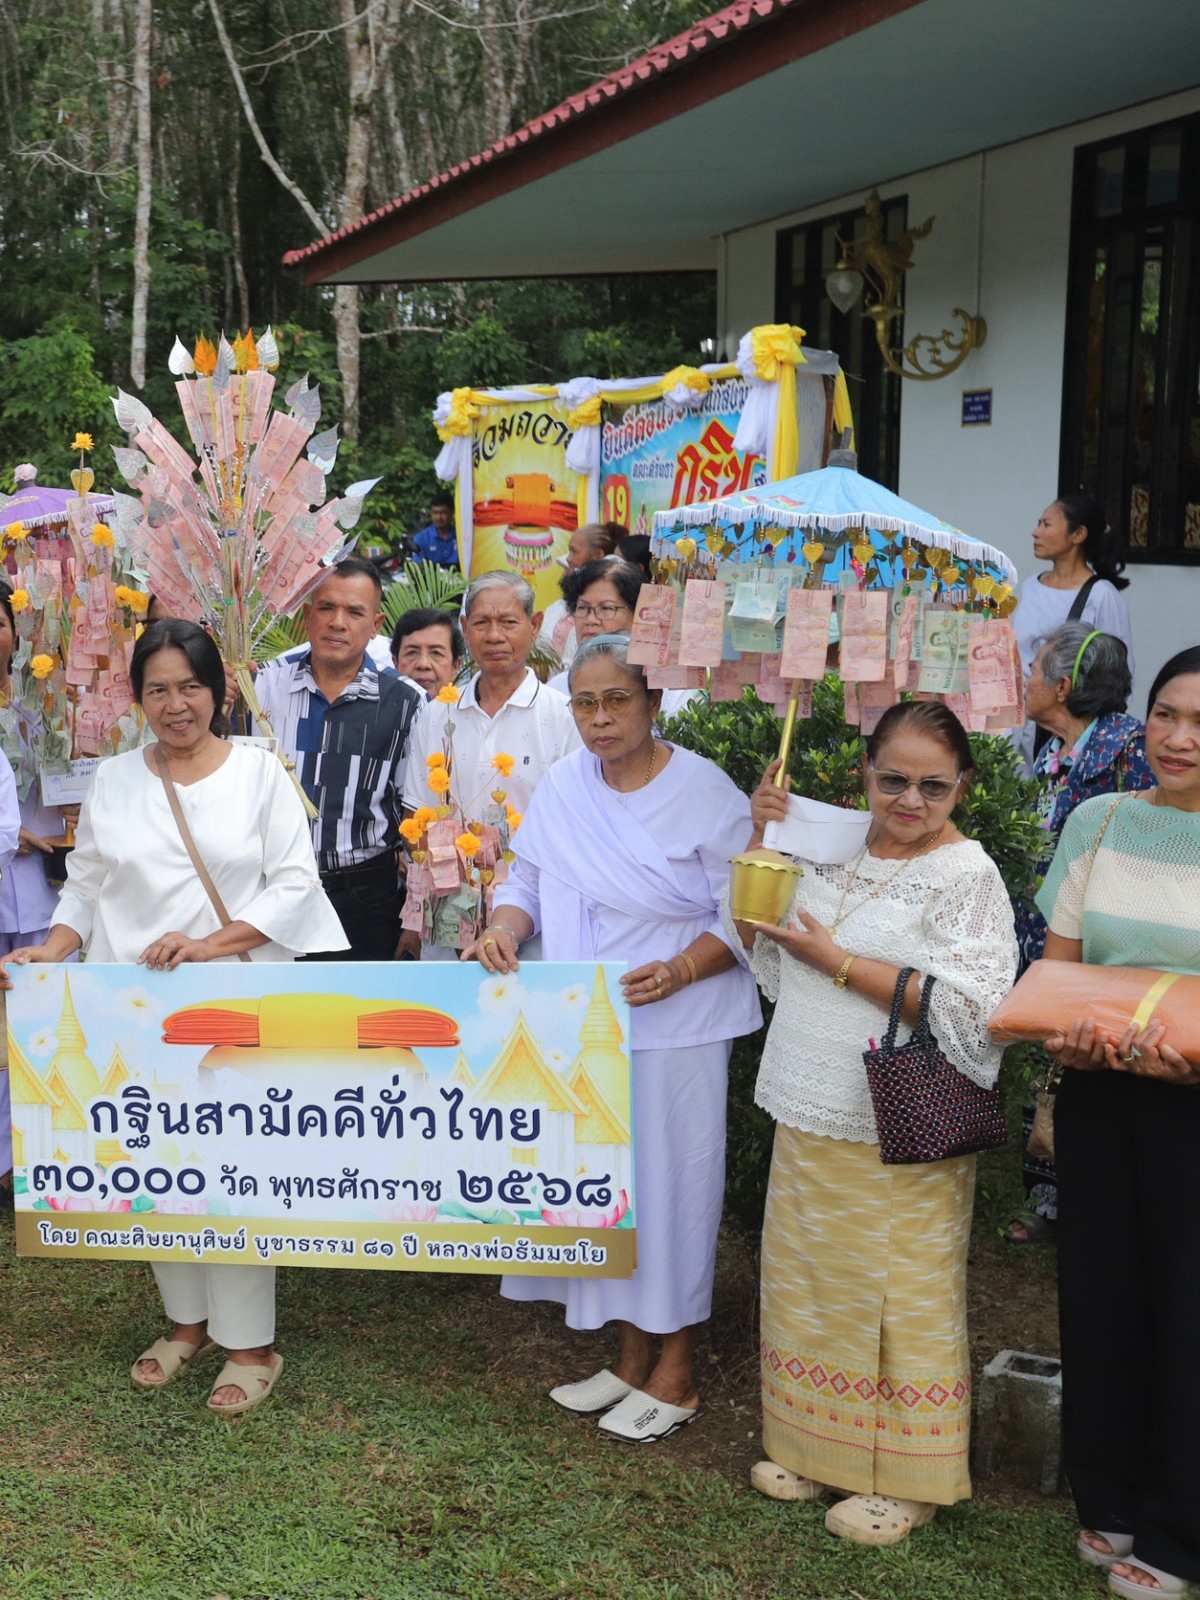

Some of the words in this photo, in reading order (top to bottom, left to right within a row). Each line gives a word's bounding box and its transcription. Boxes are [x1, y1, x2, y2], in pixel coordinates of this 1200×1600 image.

[471, 411, 574, 469] ร่วมถวา
[605, 485, 628, 525] 19
[90, 1074, 541, 1149] กฐินสามัคคีทั่วไทย
[33, 1164, 206, 1200] ๓๐,๐๐๐
[220, 1164, 258, 1196] วัด
[269, 1167, 442, 1210] พุทธศักราช
[457, 1169, 612, 1207] ๒๕๖๘
[39, 1223, 77, 1244] โดย
[86, 1227, 245, 1255] คณะศิษยานุศิษย์
[255, 1235, 354, 1258] บูชาธรรม
[363, 1241, 394, 1256] ๘๑
[403, 1235, 417, 1256] ปี
[427, 1238, 605, 1263] หลวงพ่อธัมมชโย
